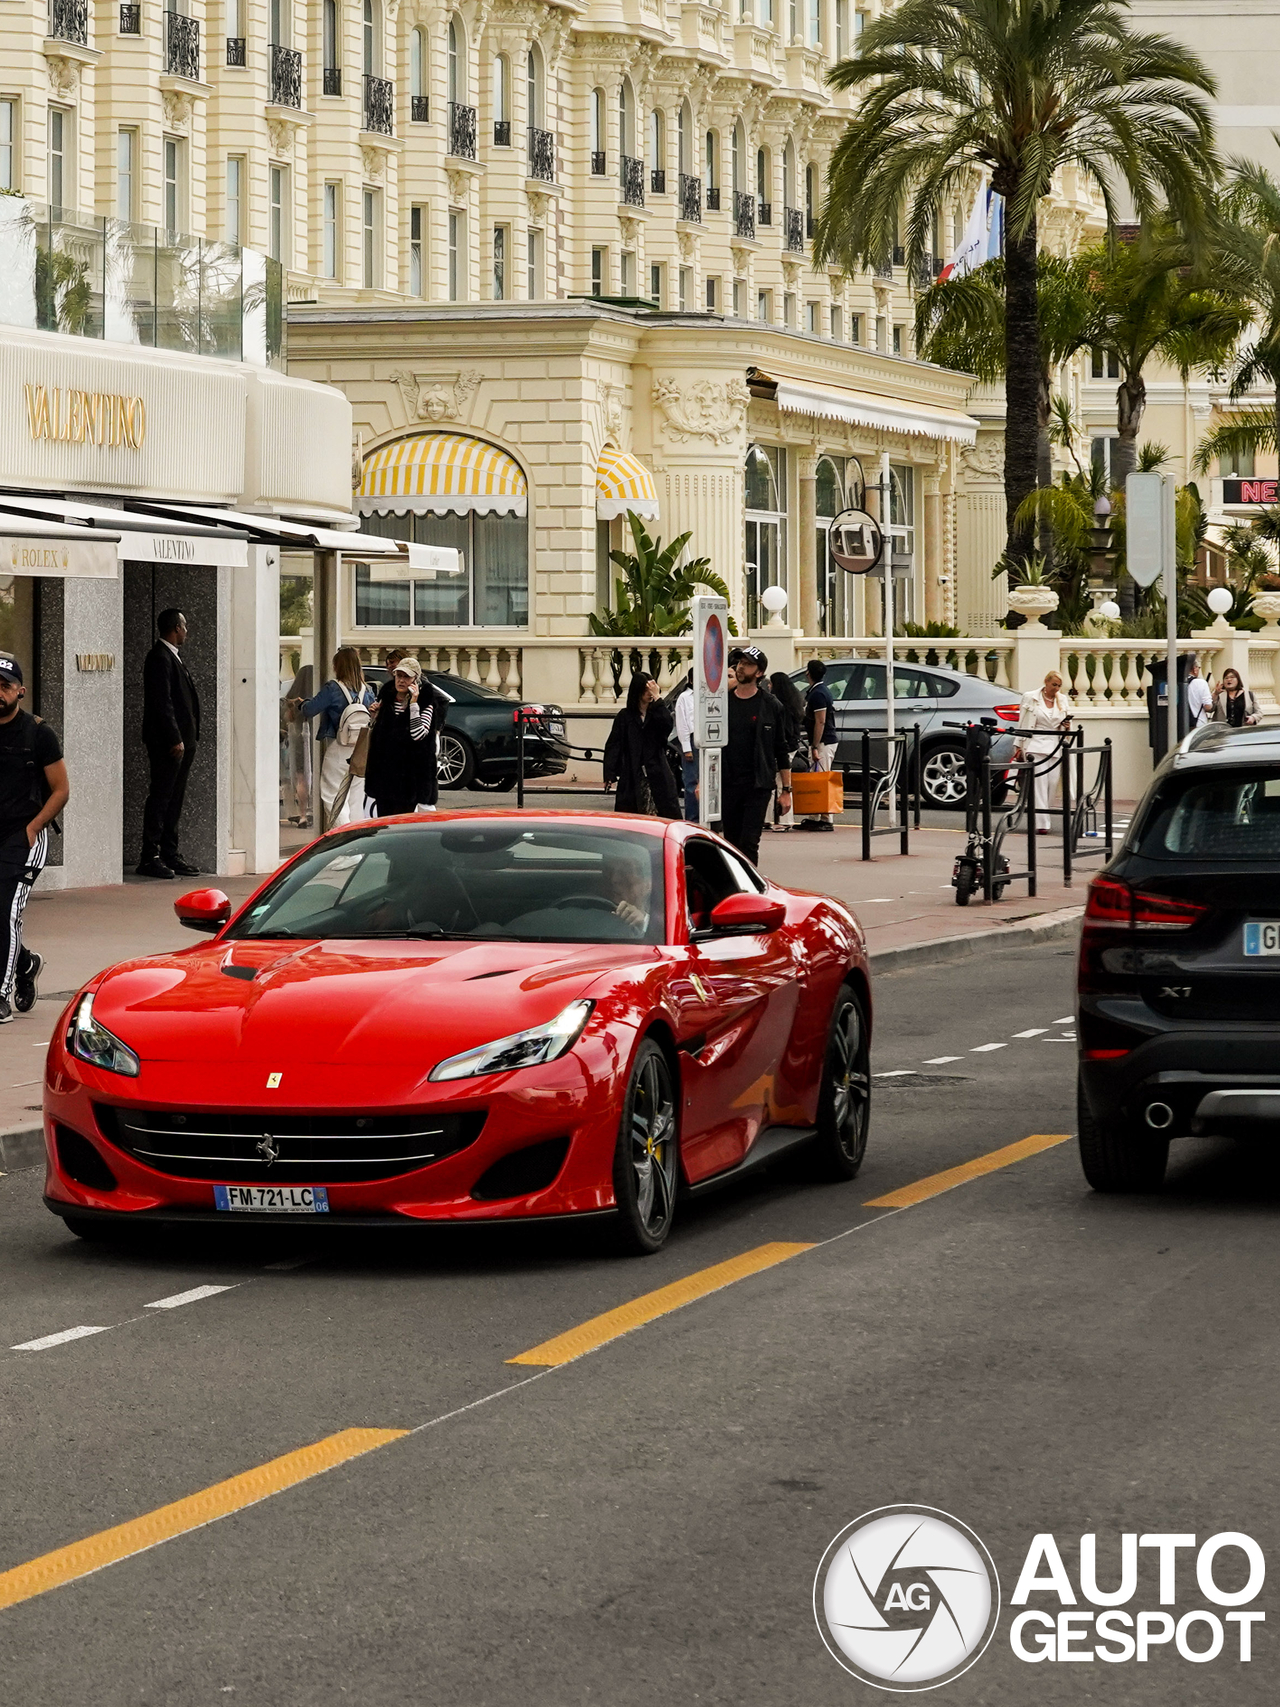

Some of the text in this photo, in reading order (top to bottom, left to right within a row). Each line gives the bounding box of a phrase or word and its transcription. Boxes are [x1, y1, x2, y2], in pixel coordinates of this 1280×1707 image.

[24, 383, 145, 449] VALENTINO
[21, 549, 59, 568] ROLEX
[153, 538, 195, 561] VALENTINO
[1263, 925, 1280, 950] G
[1159, 986, 1193, 998] X1
[229, 1188, 313, 1206] FM-721-LC
[315, 1202, 329, 1212] 06
